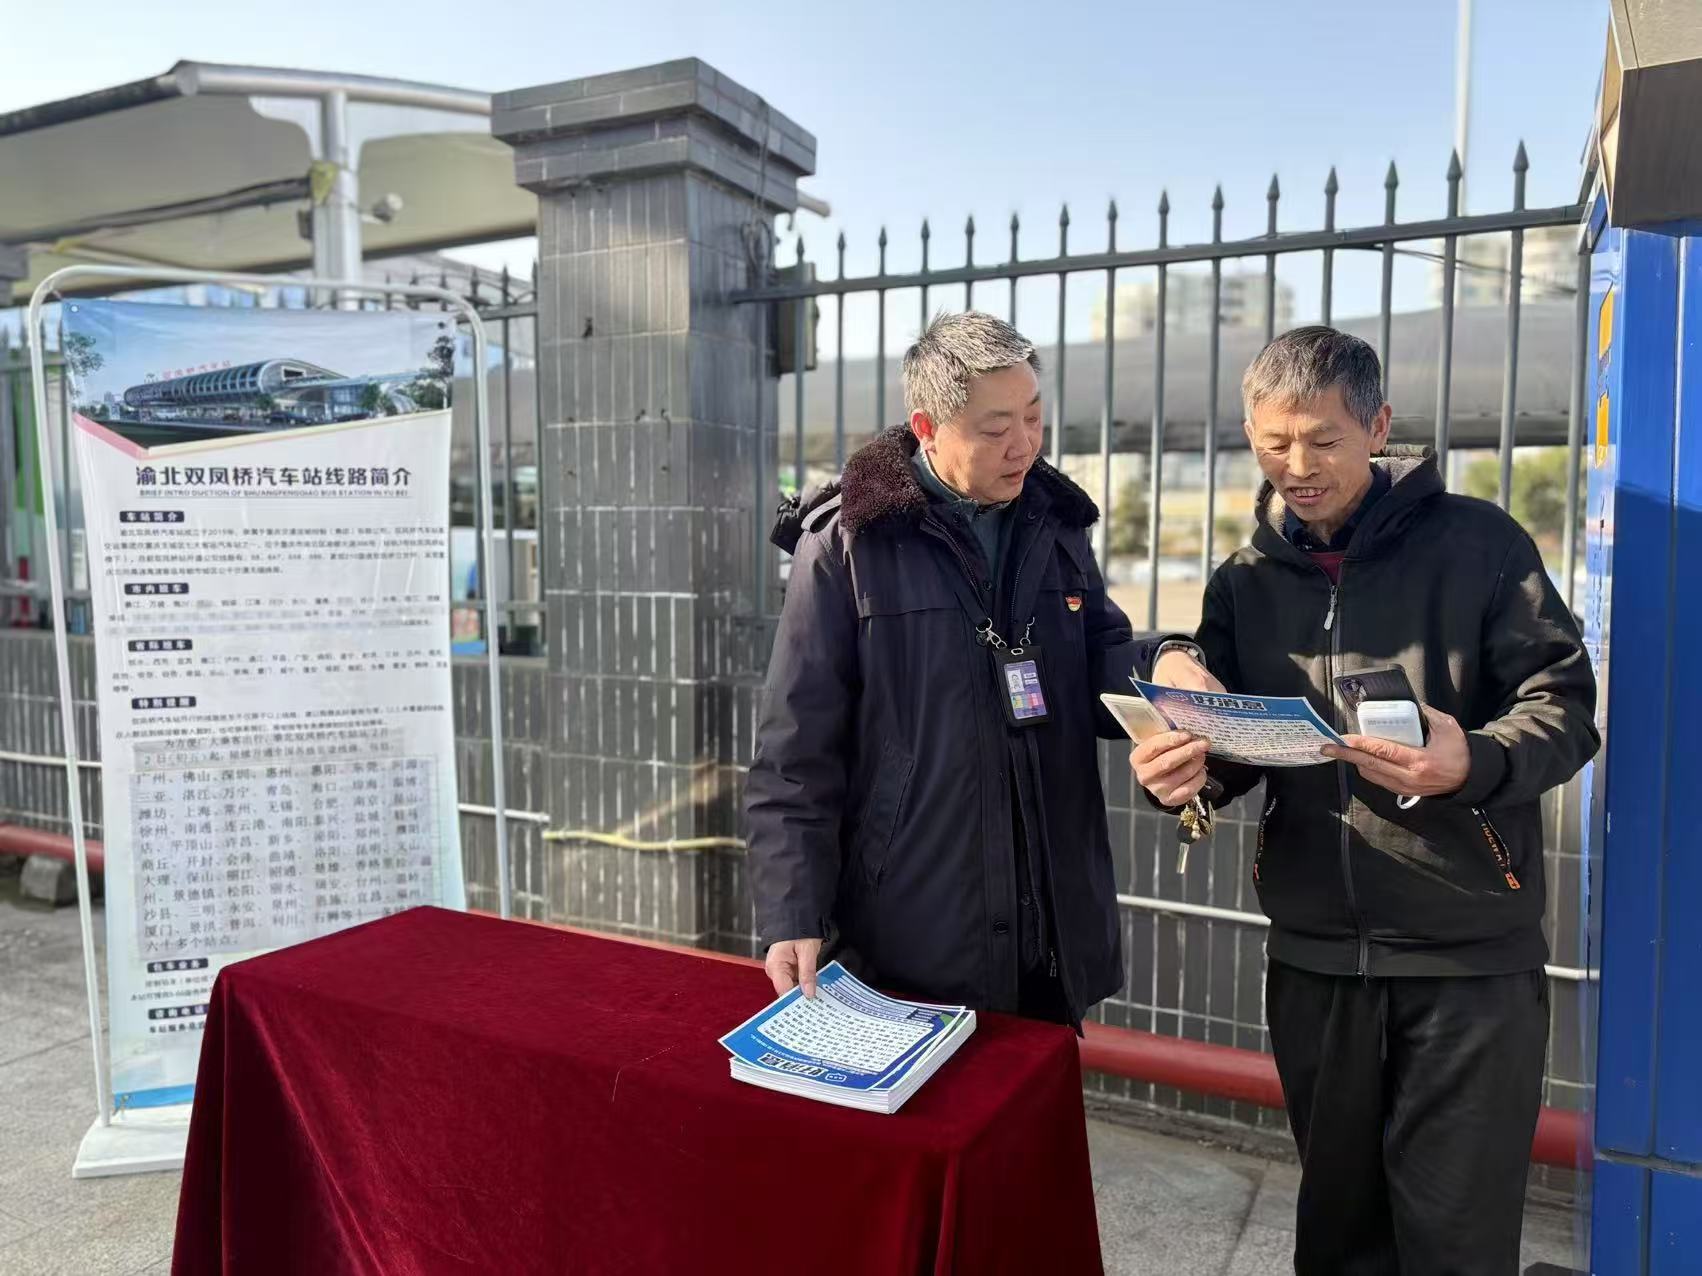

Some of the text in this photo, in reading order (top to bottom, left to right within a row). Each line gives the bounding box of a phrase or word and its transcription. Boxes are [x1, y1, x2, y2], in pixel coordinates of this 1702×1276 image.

[136, 466, 412, 486] 渝北双凤桥汽车站线路简介
[140, 489, 162, 497] BRIEF
[127, 512, 177, 522] 车站简介
[1191, 694, 1266, 711] 好消息
[758, 1053, 827, 1076] 好消息
